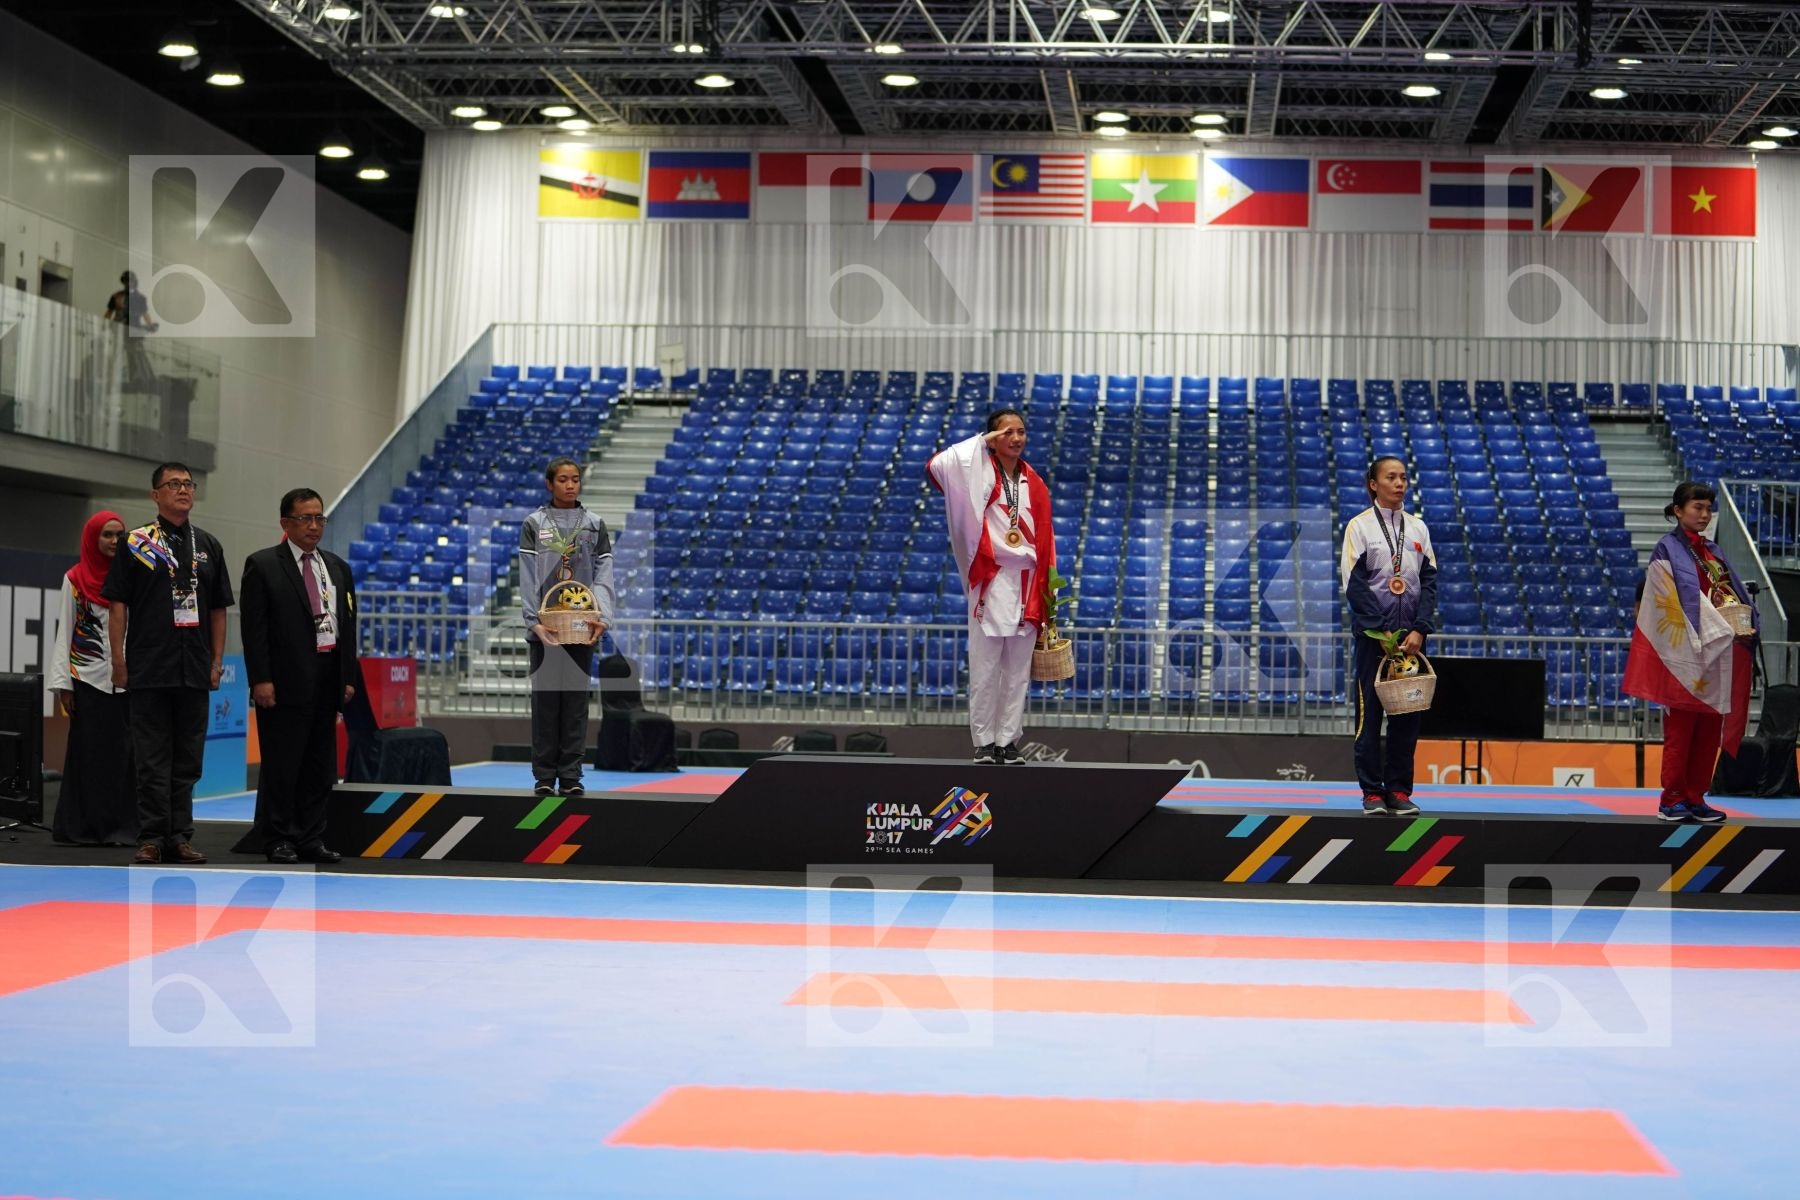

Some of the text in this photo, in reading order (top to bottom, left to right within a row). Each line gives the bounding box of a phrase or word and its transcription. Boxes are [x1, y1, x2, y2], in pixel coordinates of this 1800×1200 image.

[866, 802, 923, 816] KUALA
[866, 816, 934, 831] LUMPUR
[865, 831, 904, 844] 2017
